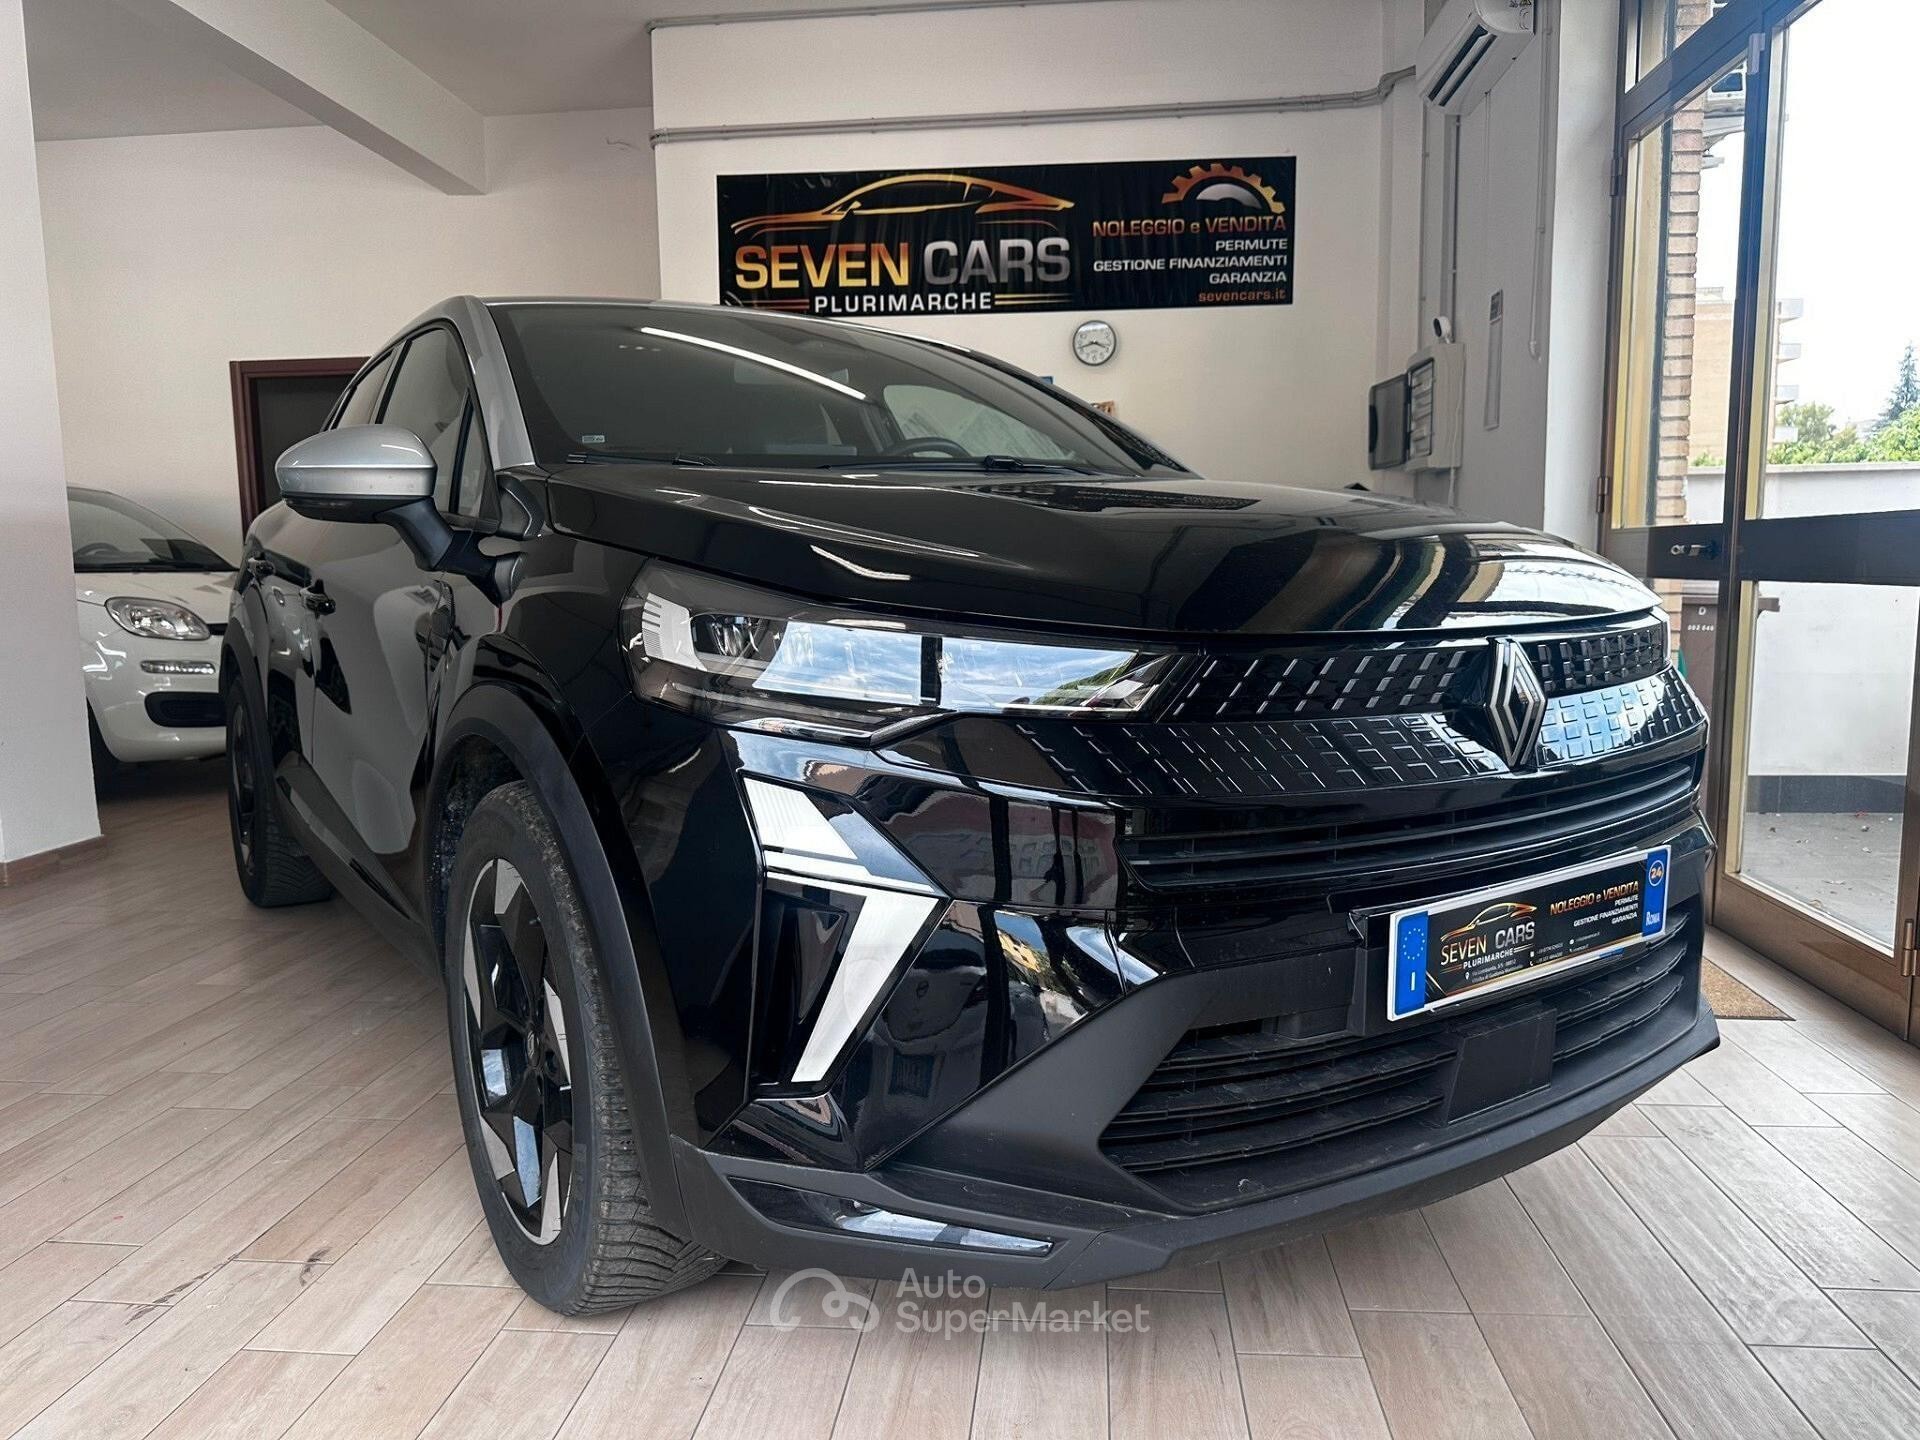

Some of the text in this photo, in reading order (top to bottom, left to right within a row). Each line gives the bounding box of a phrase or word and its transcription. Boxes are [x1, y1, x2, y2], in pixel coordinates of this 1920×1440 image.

[1092, 215, 1286, 237] NOLEGGIO e VENDITA
[1215, 238, 1288, 251] PERMUTE
[735, 237, 1071, 289] SEVEN CARS
[1093, 255, 1287, 272] GESTIONE FINANZIAMENTI
[1209, 271, 1287, 284] GARANZIA
[815, 292, 991, 313] PLURIMARCHE
[1199, 288, 1286, 302] sevencars.it
[1650, 866, 1663, 879] 24
[1550, 892, 1595, 915] NOLEGGIO
[1602, 880, 1639, 902] VENDITA
[1573, 902, 1639, 927] GESTIONE FINANZIAMENTI
[1611, 911, 1638, 925] GARANZIA
[1440, 934, 1487, 966] SEVEN
[1495, 921, 1535, 949] CARS
[1463, 947, 1514, 970] PLURIMARCHE
